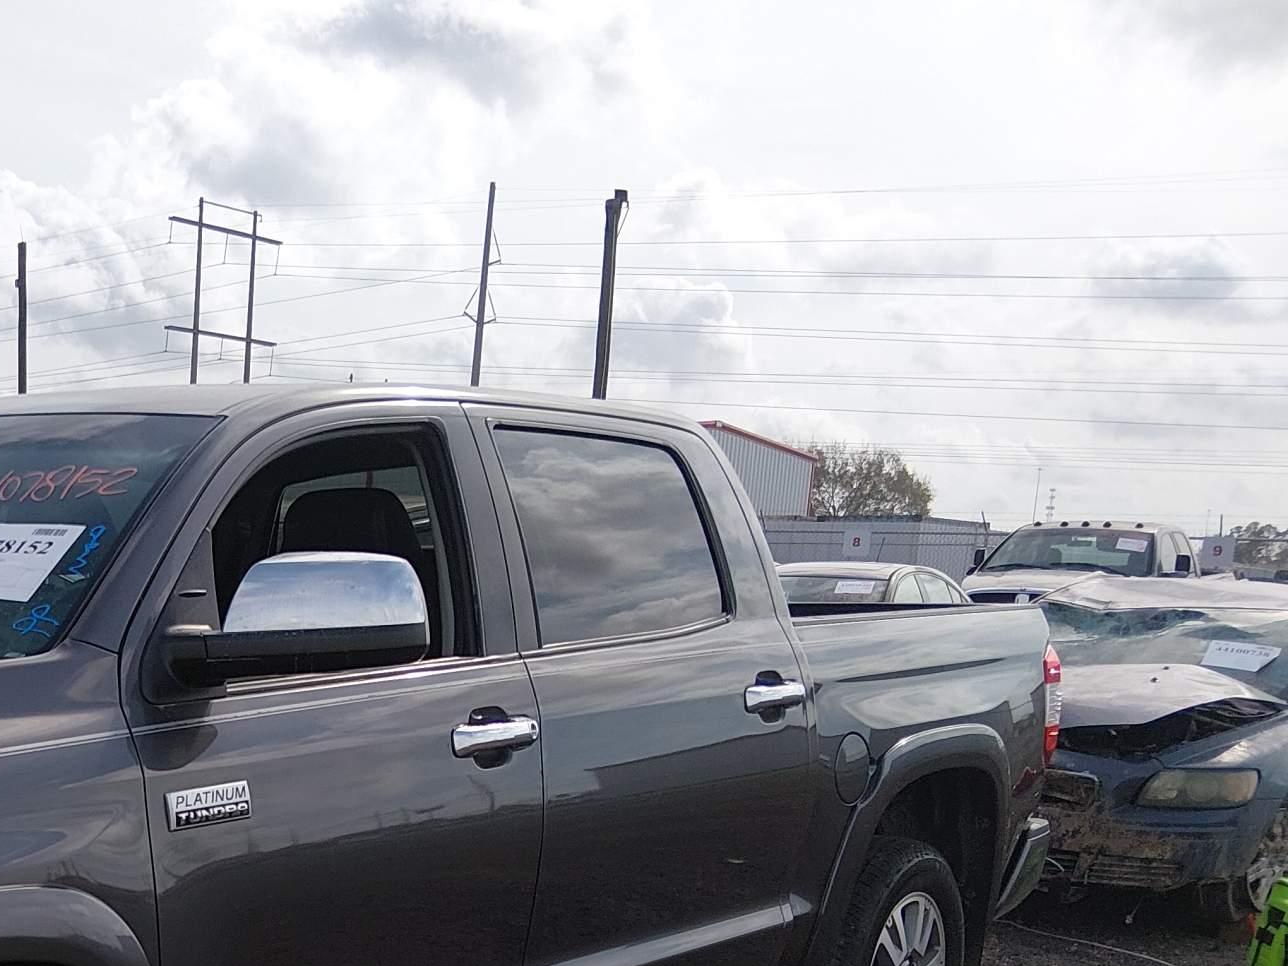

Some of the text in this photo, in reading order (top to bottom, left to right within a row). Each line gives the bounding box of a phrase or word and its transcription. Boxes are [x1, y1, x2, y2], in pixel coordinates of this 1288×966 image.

[852, 536, 861, 548] 8
[1213, 545, 1223, 556] 9
[176, 784, 247, 809] PLATINUM
